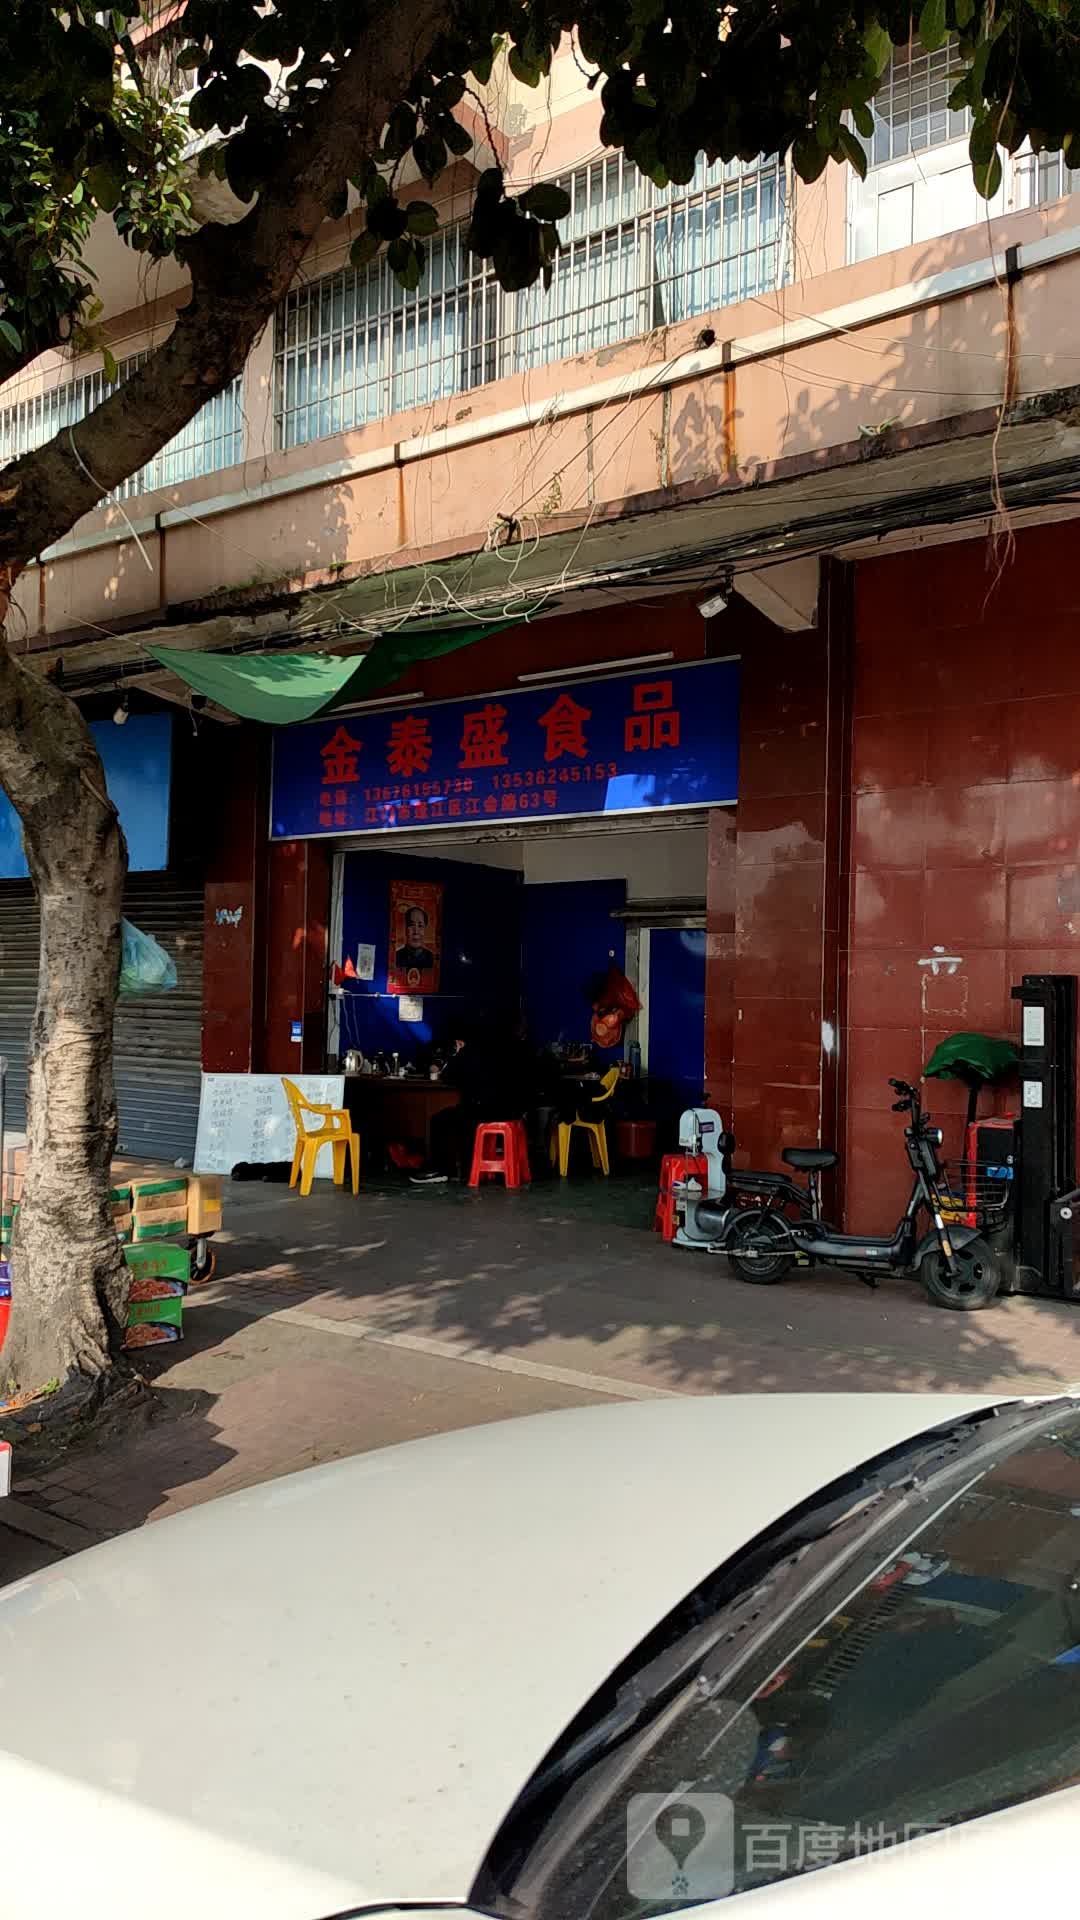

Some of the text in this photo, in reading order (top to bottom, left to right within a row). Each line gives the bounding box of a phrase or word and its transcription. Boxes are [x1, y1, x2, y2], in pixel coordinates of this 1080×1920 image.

[320, 681, 680, 785] 金泰盛食品
